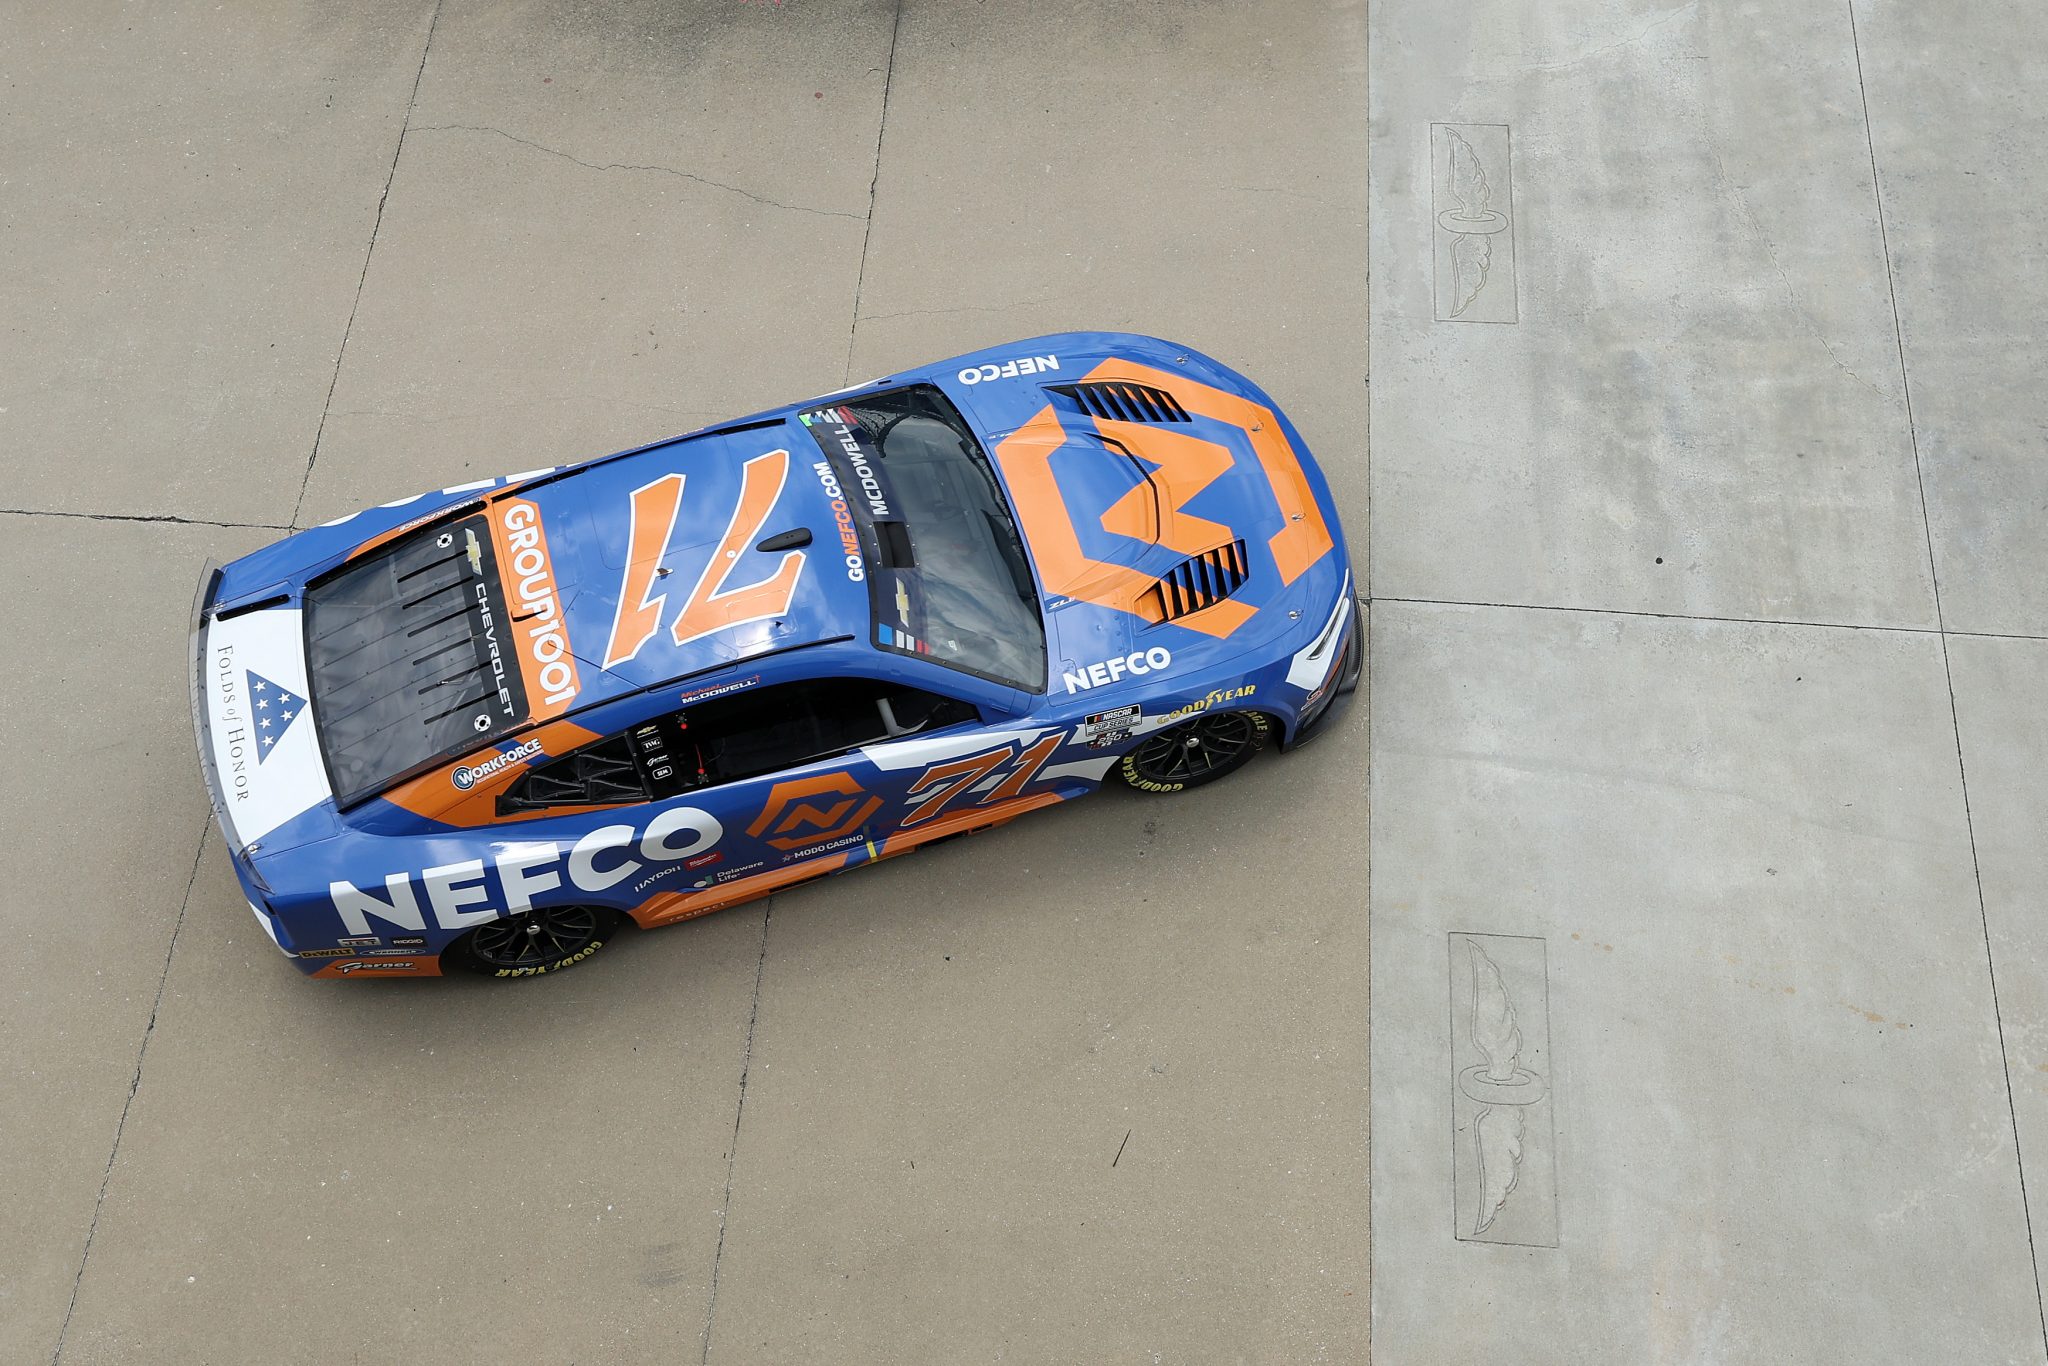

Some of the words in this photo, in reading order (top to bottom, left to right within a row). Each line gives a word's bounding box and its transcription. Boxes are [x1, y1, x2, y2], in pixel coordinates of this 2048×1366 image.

[958, 354, 1061, 386] NEFCO
[833, 424, 889, 516] MCDOWELL
[812, 462, 865, 582] GONEFCO.COM
[600, 449, 807, 673] 71
[504, 503, 573, 706] GROUP1001
[475, 583, 515, 717] CHEVROLET
[1062, 646, 1172, 694] NEFCO
[217, 644, 236, 704] FOLDS
[682, 680, 757, 704] McDOWELL
[221, 706, 238, 722] of
[1103, 708, 1133, 720] NASCAR
[1157, 684, 1257, 724] GOODYEAR
[227, 728, 250, 803] HONOR
[457, 738, 542, 785] WORKFORCE
[900, 730, 1067, 827] 71
[1122, 752, 1184, 792] GOODYEAR
[717, 861, 764, 878] Delaware
[794, 845, 826, 859] MODO
[826, 834, 865, 850] CASINO
[330, 807, 724, 936] NEFCO
[495, 941, 603, 977] GOODYEAR
